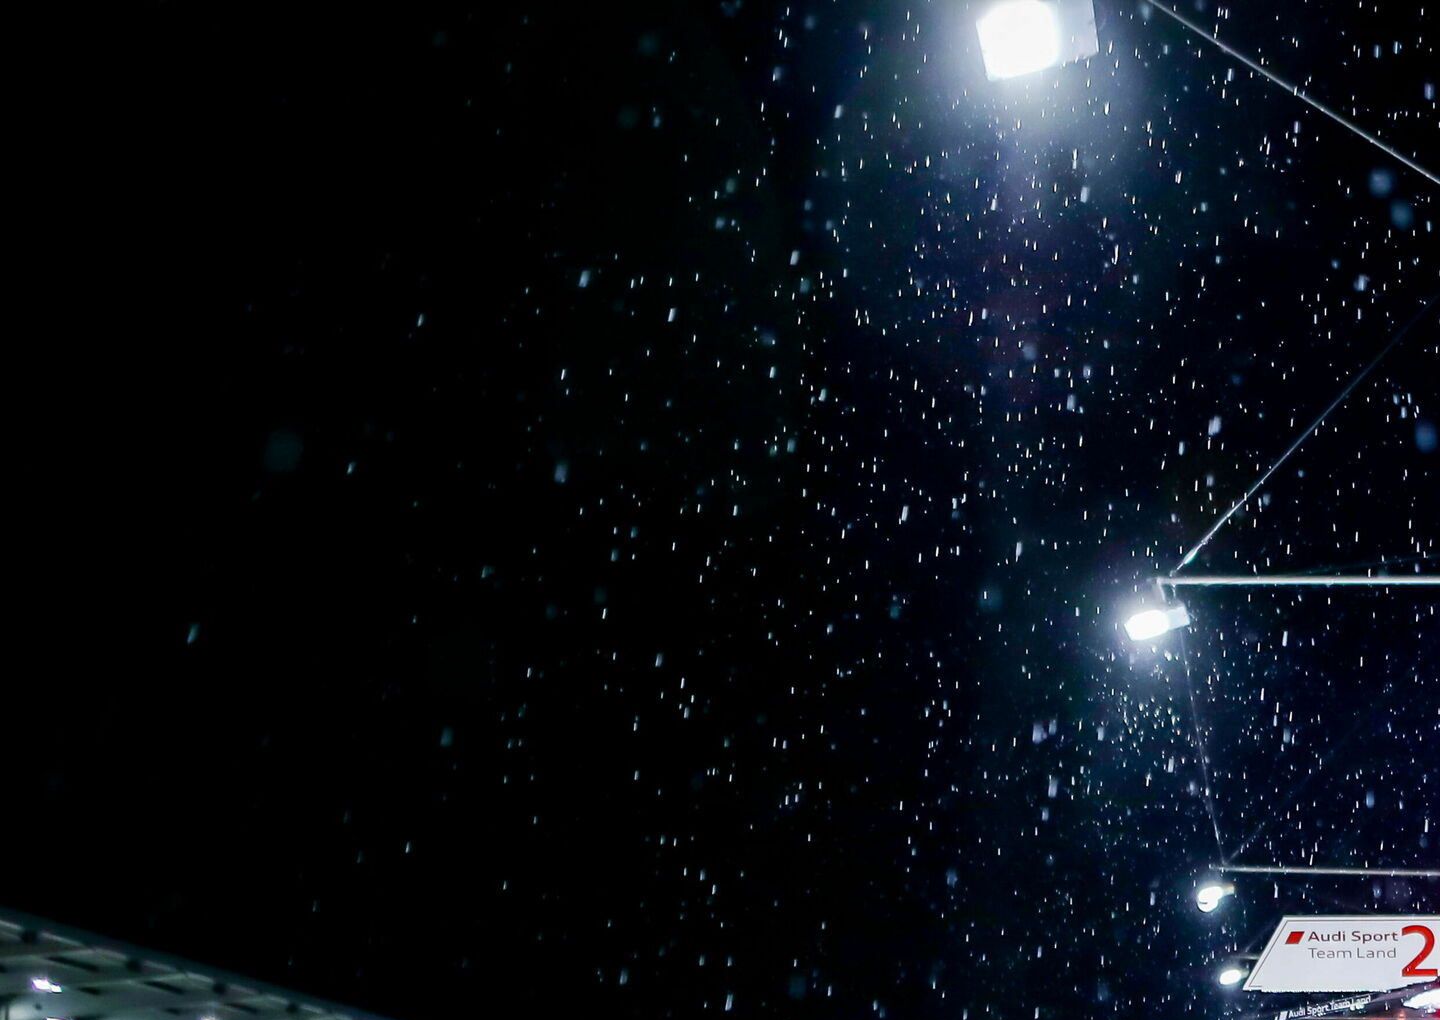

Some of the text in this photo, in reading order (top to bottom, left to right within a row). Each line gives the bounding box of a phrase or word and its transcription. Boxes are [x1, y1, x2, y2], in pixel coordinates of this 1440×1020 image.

[1308, 930, 1399, 945] Audi Sport
[1308, 947, 1397, 959] Team Land
[1288, 1007, 1306, 1018] Audi
[1307, 1003, 1329, 1014] Sport
[1329, 1000, 1351, 1010] Team
